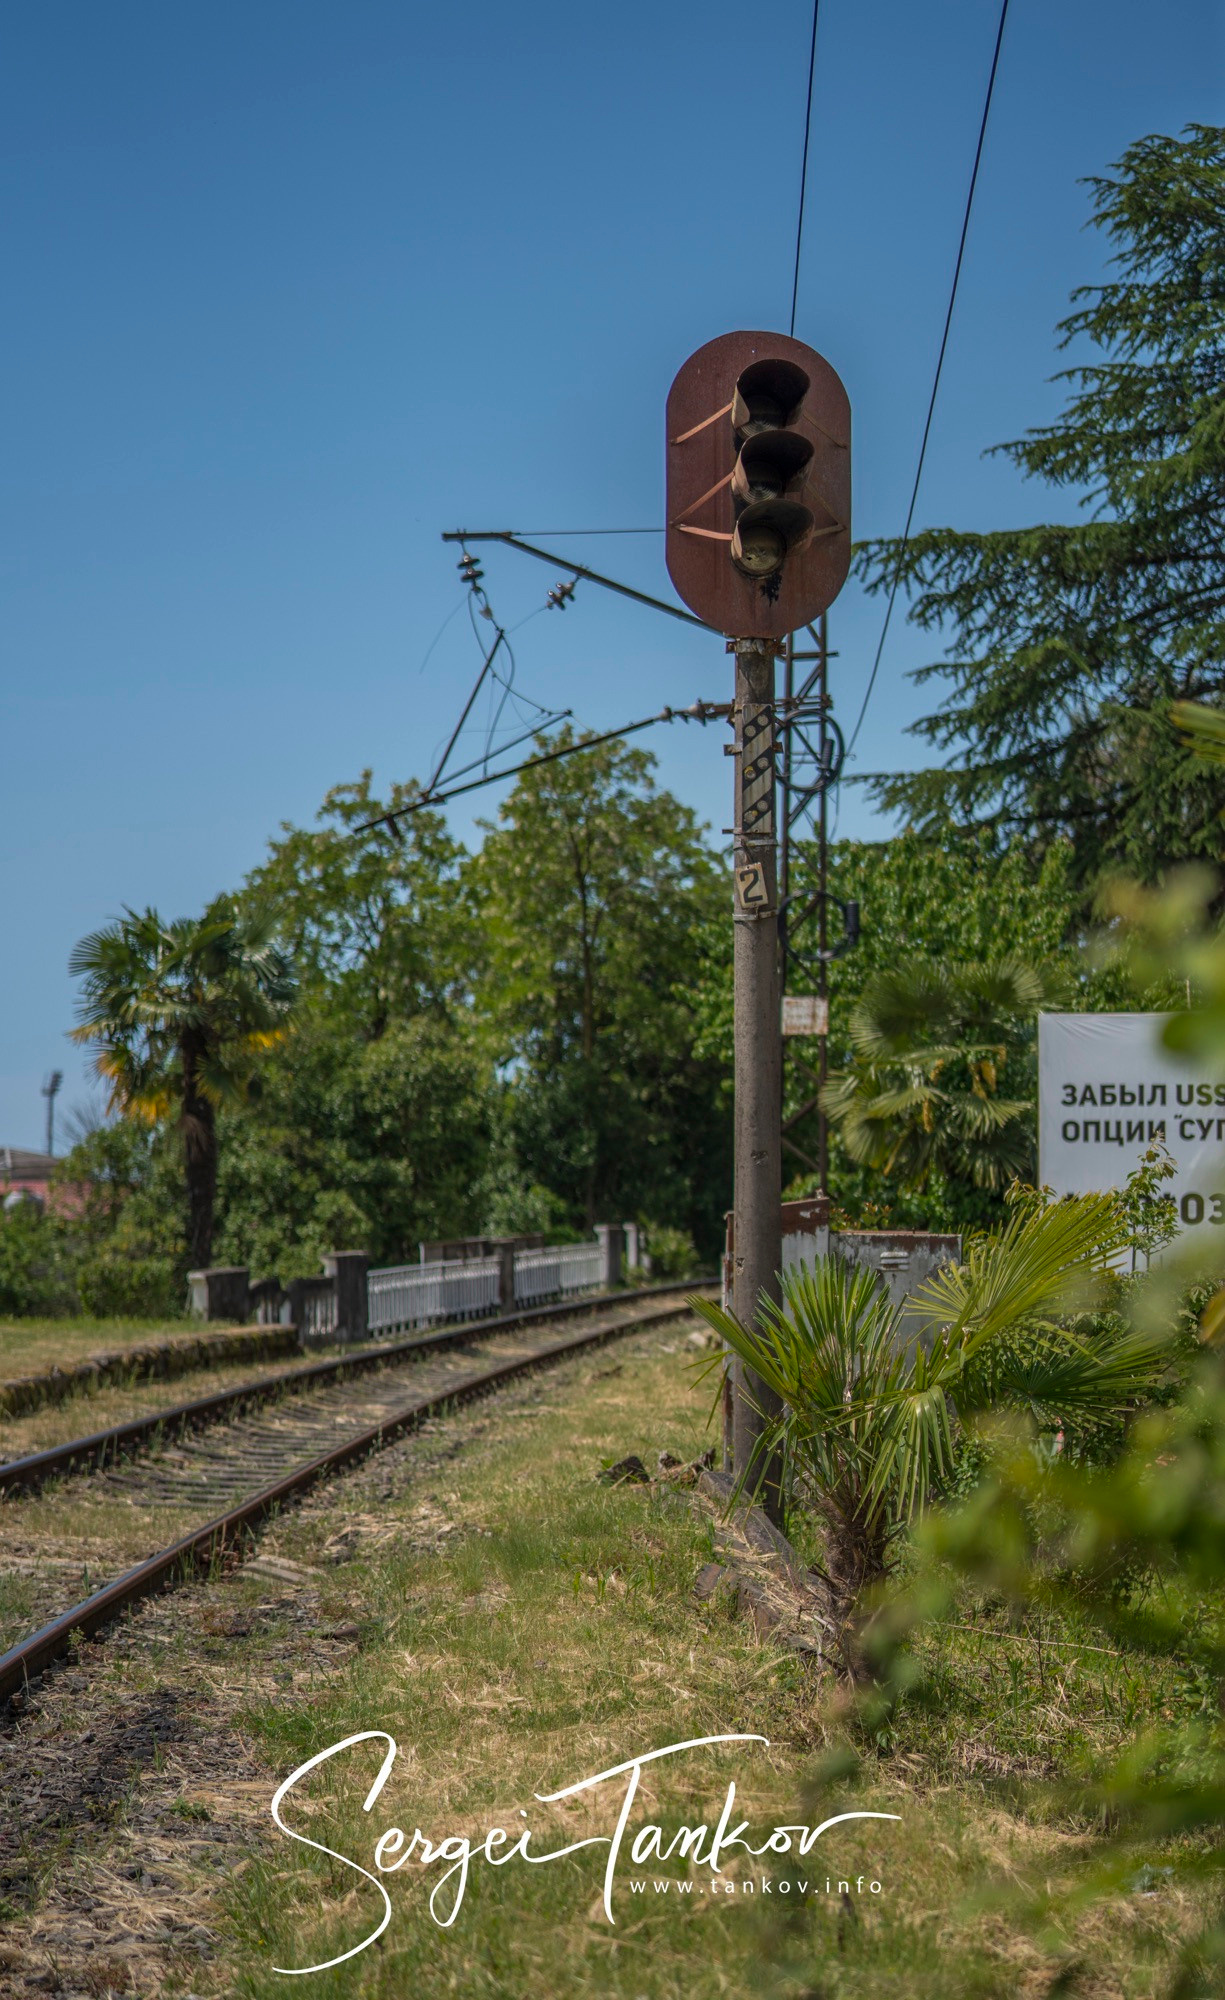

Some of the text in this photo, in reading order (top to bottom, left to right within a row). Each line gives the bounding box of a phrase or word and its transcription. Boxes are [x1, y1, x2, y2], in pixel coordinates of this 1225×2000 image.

[740, 869, 763, 903] 2
[1061, 1084, 1167, 1107] ЗАБЫЛ
[1061, 1120, 1166, 1147] ОПЦИИ
